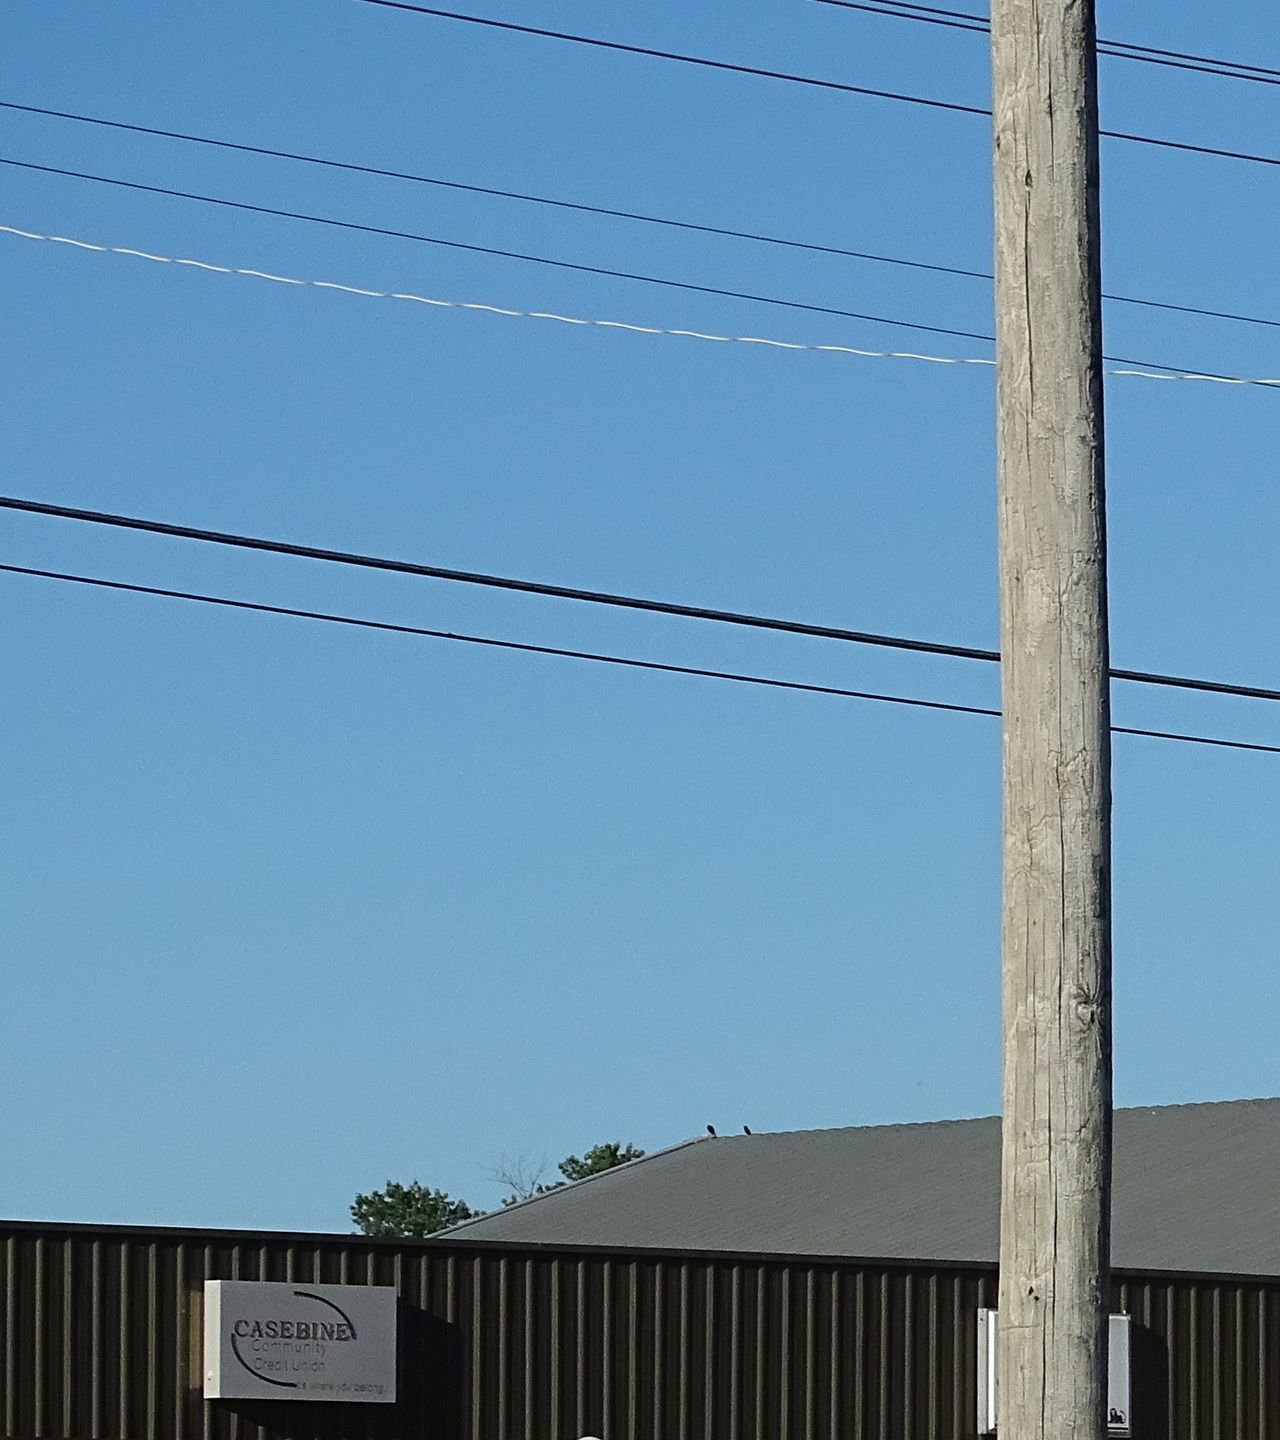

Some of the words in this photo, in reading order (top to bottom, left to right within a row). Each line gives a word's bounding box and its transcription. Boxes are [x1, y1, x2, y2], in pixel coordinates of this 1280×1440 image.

[234, 1319, 351, 1341] CASEBINE
[252, 1339, 327, 1357] Community
[254, 1357, 288, 1371] Credit
[292, 1358, 326, 1372] Union
